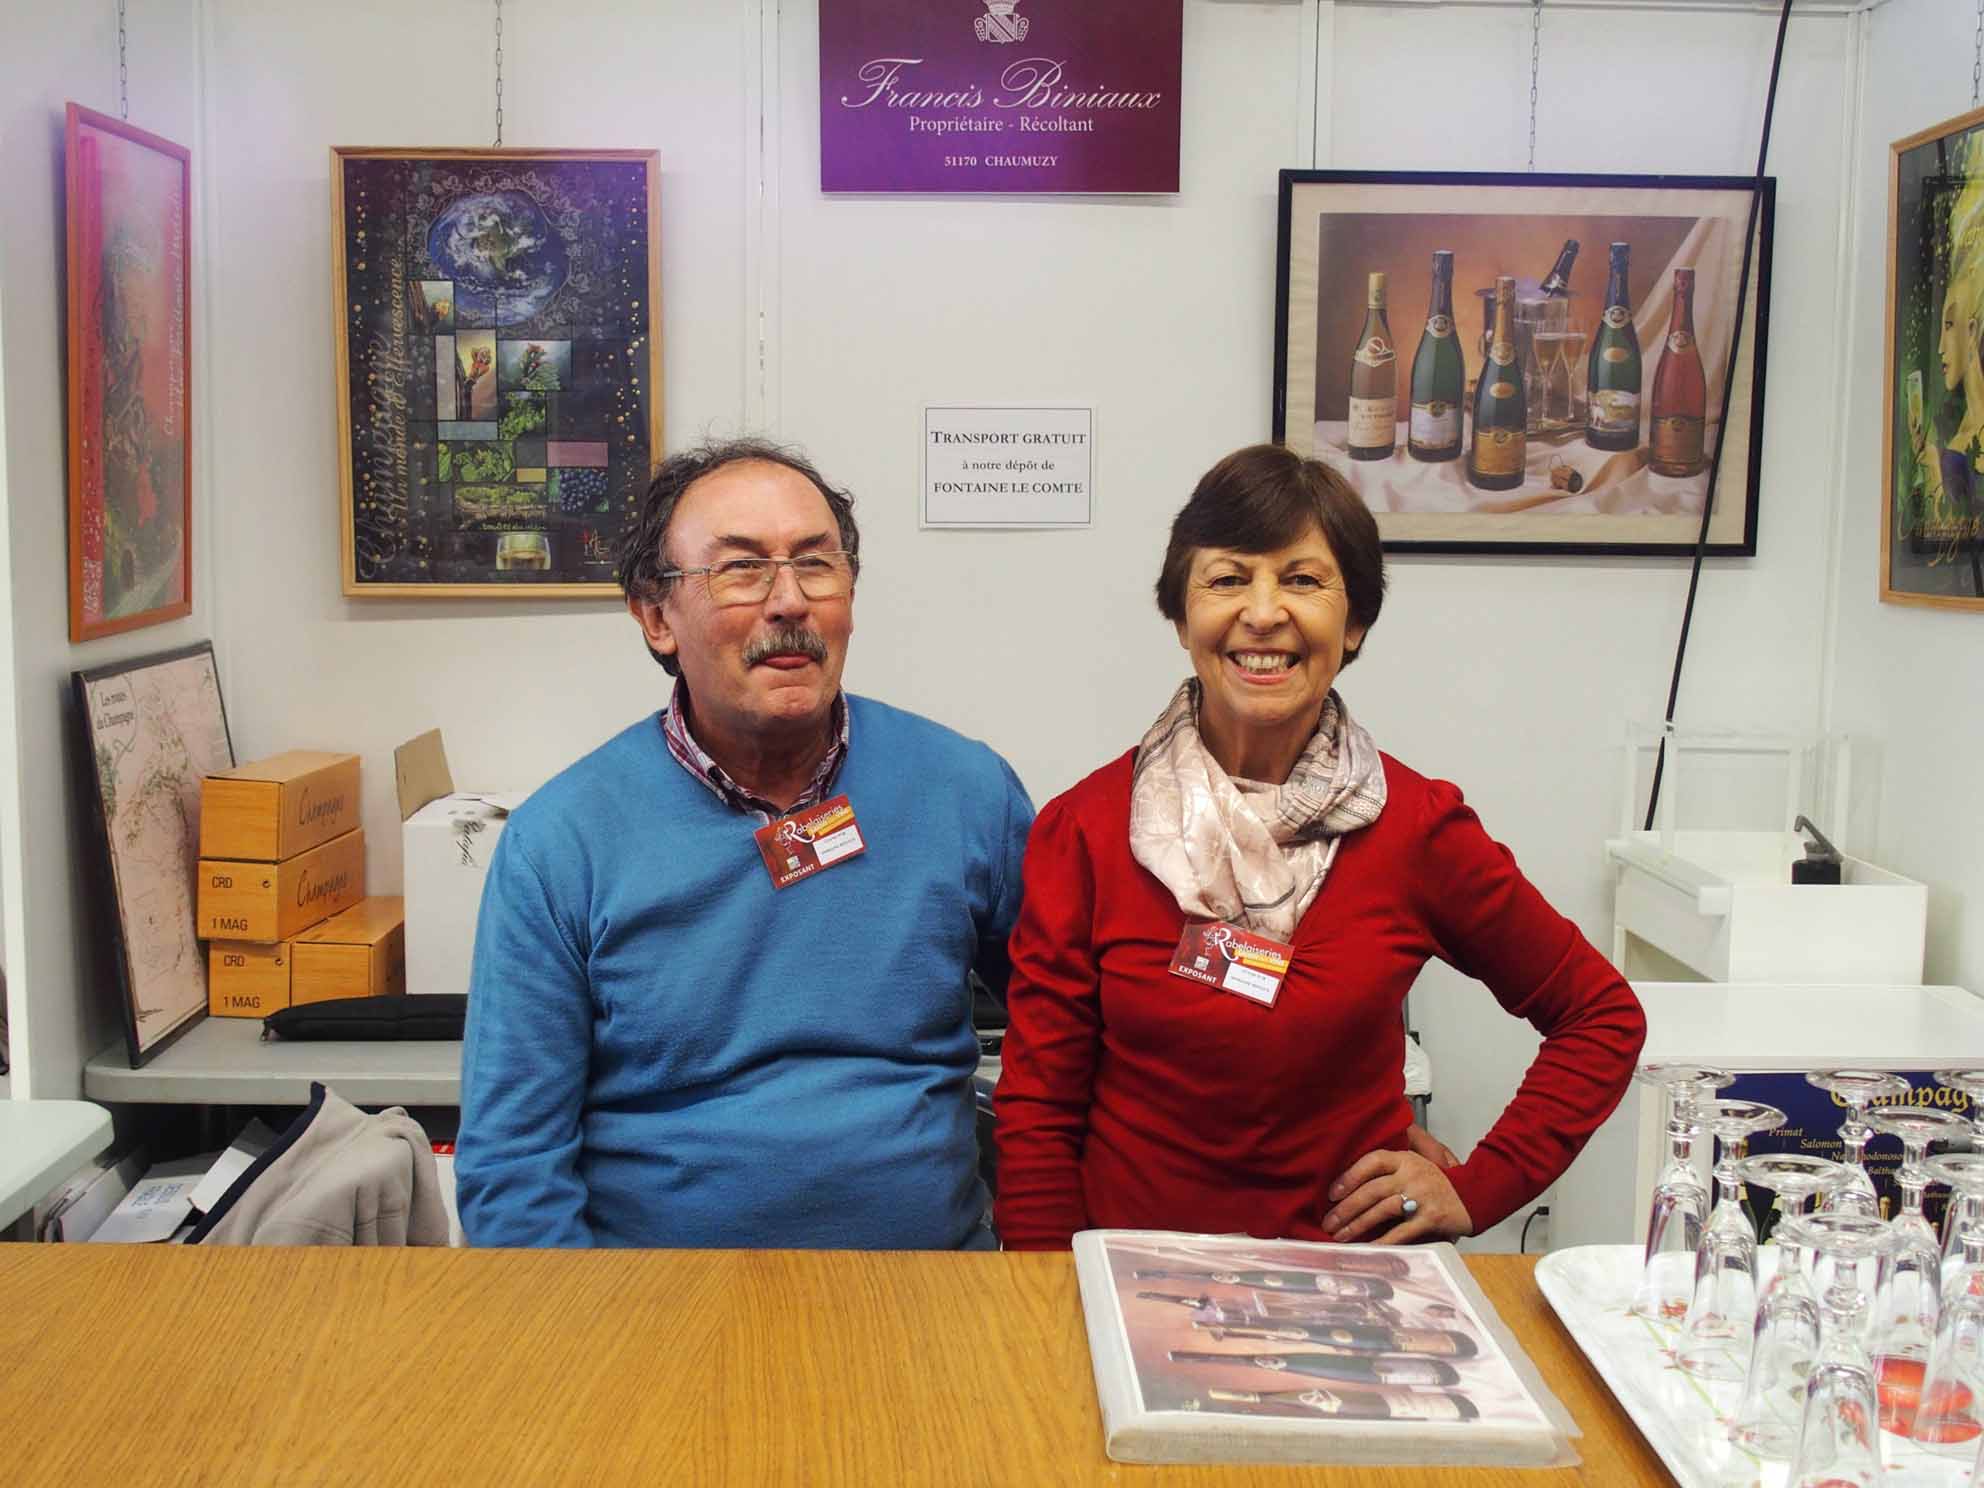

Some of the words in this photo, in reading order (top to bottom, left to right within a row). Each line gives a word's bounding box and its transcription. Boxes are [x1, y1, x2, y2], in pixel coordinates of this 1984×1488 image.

[841, 58, 985, 109] Francis
[993, 58, 1161, 109] Biniaux
[909, 115, 1003, 135] Propriétaire
[1019, 115, 1094, 132] Récoltant
[944, 156, 977, 167] 51170
[984, 155, 1058, 167] CHAUMUZY
[930, 431, 1019, 444] TRANSPORT
[1022, 432, 1087, 445] GRATUIT
[962, 460, 968, 470] à
[972, 461, 1001, 470] notre
[1005, 459, 1038, 473] dépôt
[1041, 459, 1055, 471] de
[933, 482, 1009, 494] FONTAINE
[1011, 482, 1030, 494] LE
[1032, 482, 1084, 494] COMTE
[780, 863, 815, 883] EXPOSANT
[211, 876, 233, 889] CRD
[219, 918, 248, 932] MAG
[1214, 927, 1281, 961] Rabelaiseries
[223, 954, 245, 968] CRD
[1178, 965, 1217, 984] EXPOSANT
[231, 996, 260, 1009] MAG
[1768, 1127, 1803, 1137] Primat
[1800, 1138, 1842, 1149] Salomon
